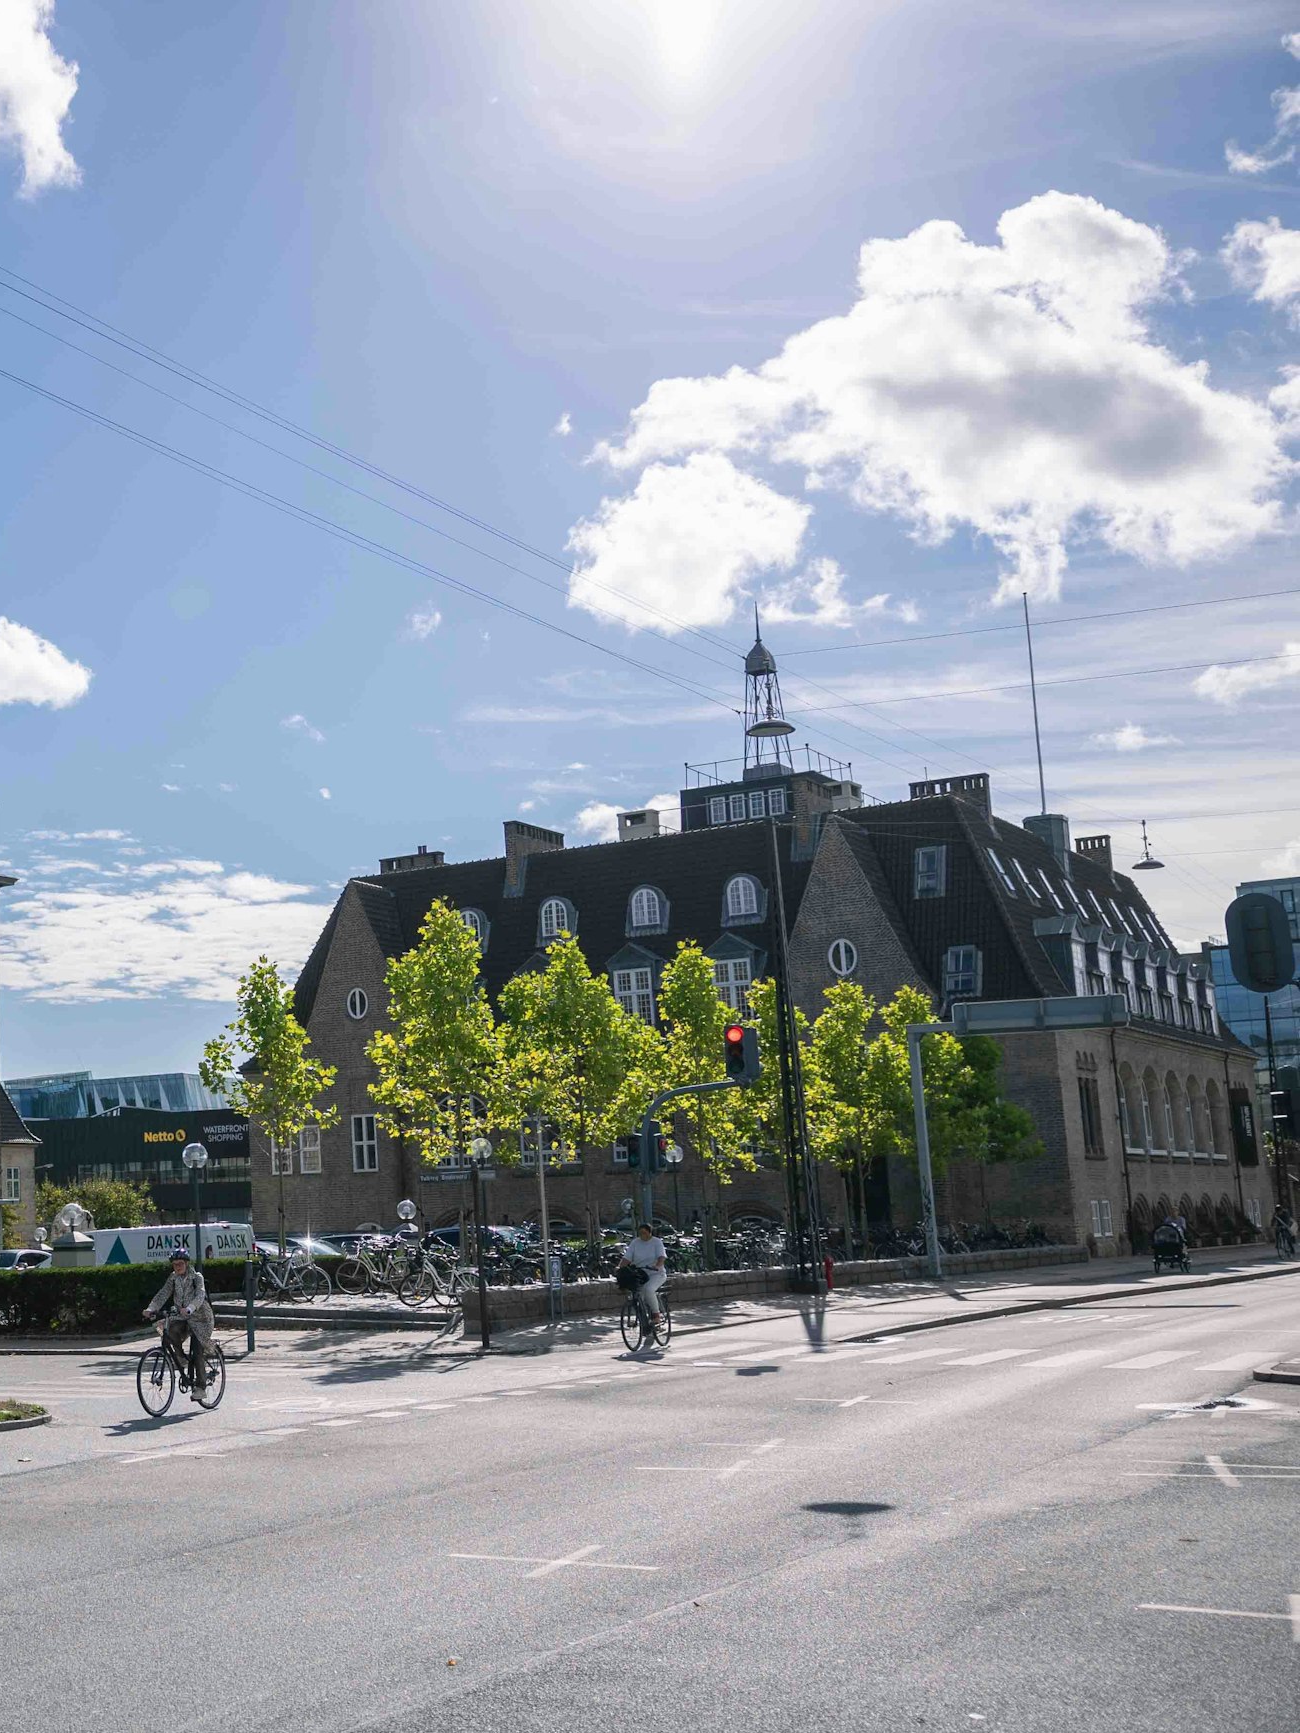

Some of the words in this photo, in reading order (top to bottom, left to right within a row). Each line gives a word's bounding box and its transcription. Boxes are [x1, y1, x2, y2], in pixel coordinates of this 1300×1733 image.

[203, 1124, 249, 1133] WATERFRONT
[144, 1132, 174, 1142] Netto
[207, 1133, 244, 1142] SHOPPING
[147, 1234, 190, 1250] DANSK
[217, 1235, 247, 1249] DANSK
